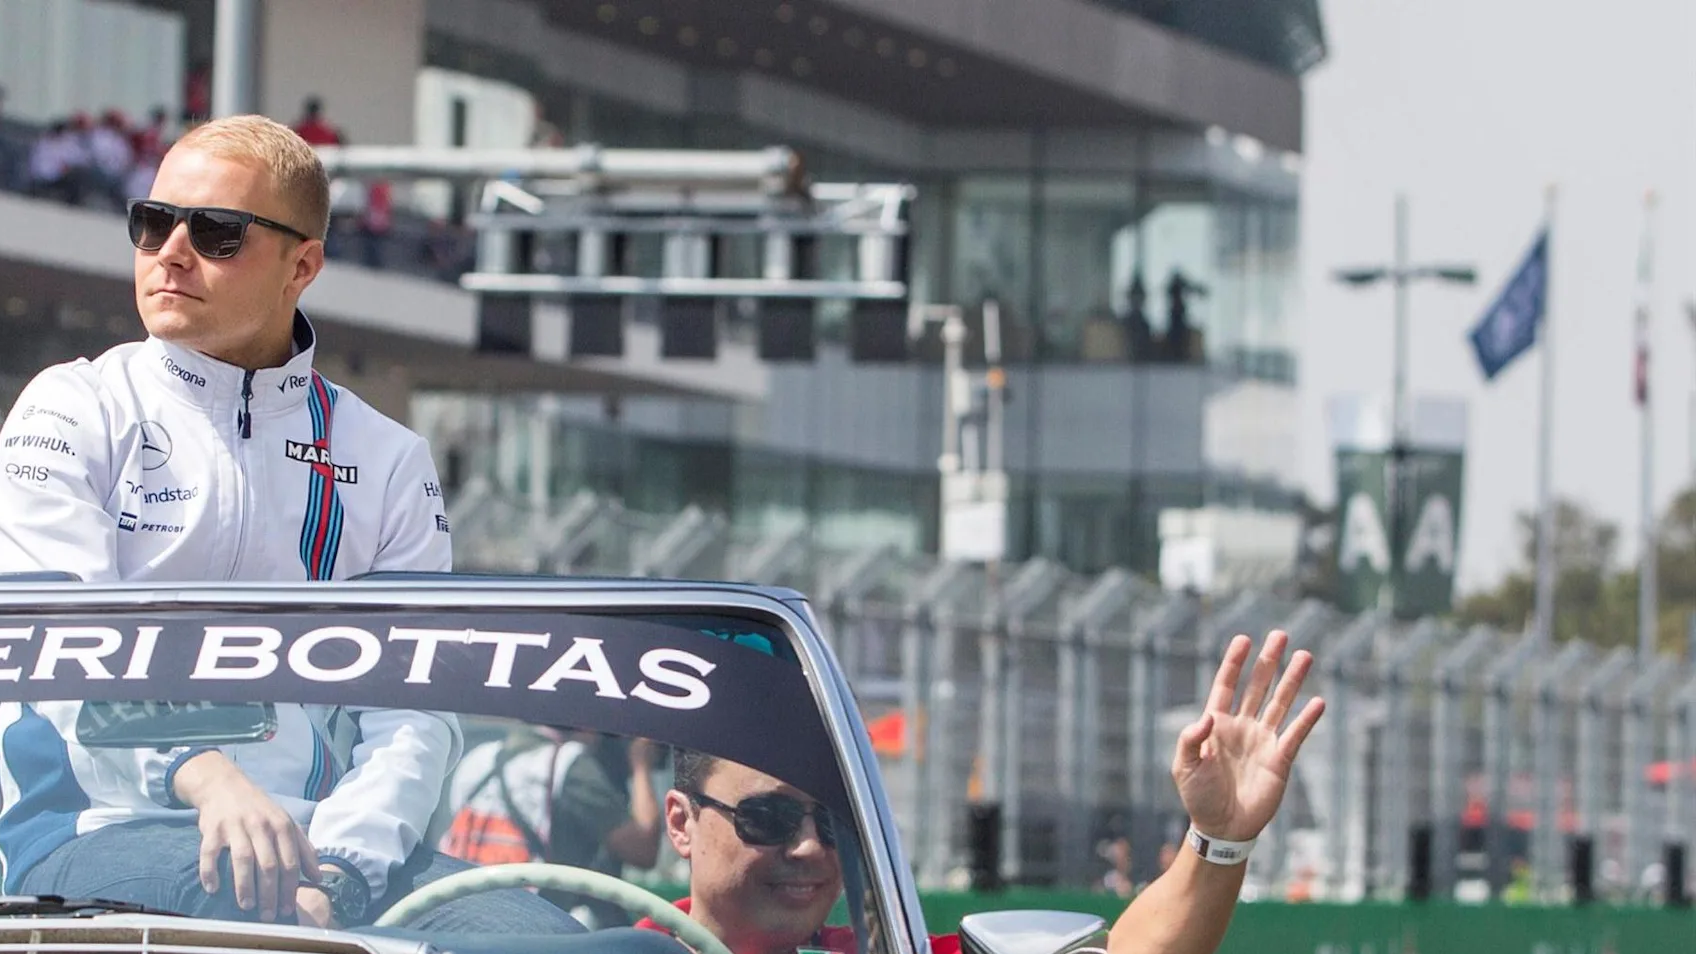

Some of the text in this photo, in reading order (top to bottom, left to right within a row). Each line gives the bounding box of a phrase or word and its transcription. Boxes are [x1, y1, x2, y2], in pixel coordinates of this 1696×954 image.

[164, 357, 206, 388] Rexona
[290, 375, 308, 389] Re
[21, 435, 76, 456] WIHUR
[5, 462, 50, 482] ORIS
[287, 442, 356, 483] MARNI
[189, 625, 717, 710] BOTTAS
